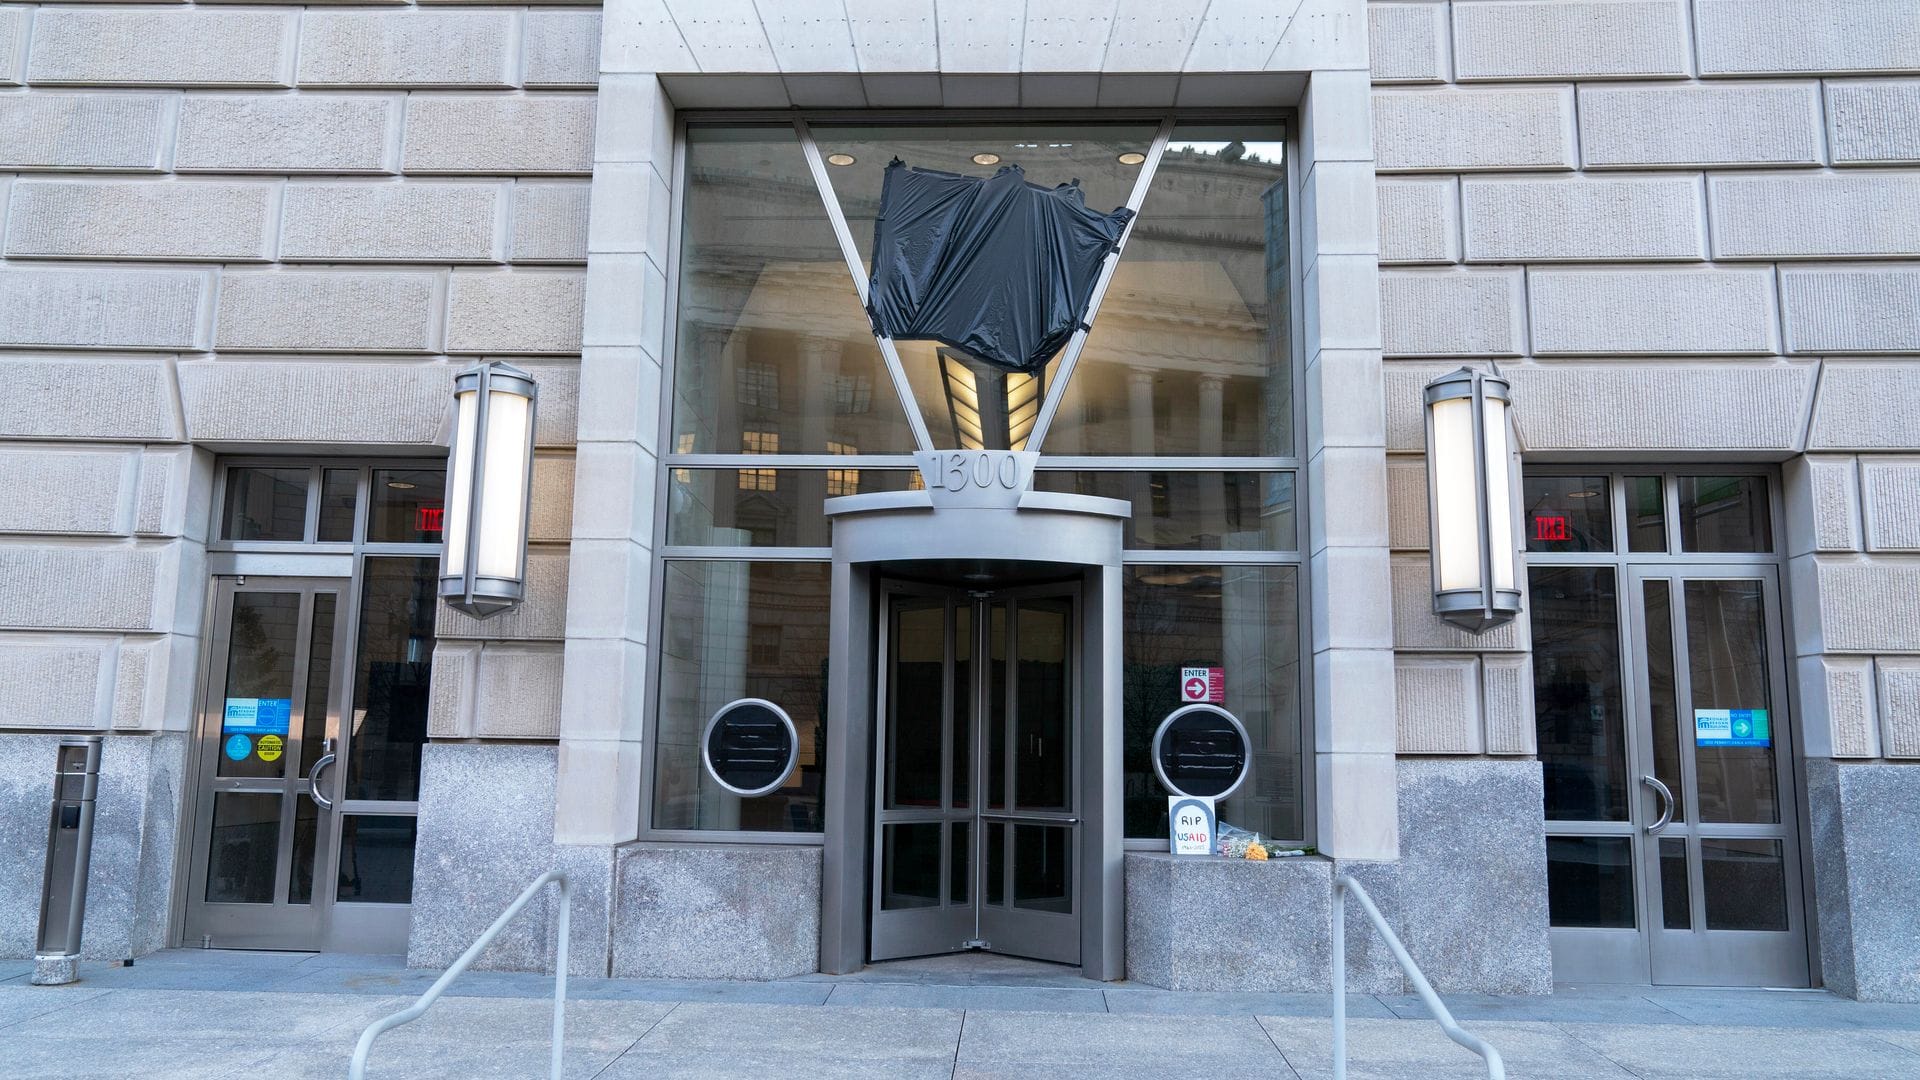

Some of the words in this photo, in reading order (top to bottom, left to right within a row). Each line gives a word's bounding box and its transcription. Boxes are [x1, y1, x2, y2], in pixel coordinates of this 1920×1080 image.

[931, 453, 1018, 493] 1300
[1181, 816, 1202, 825] RIP
[1177, 833, 1207, 842] USAID
